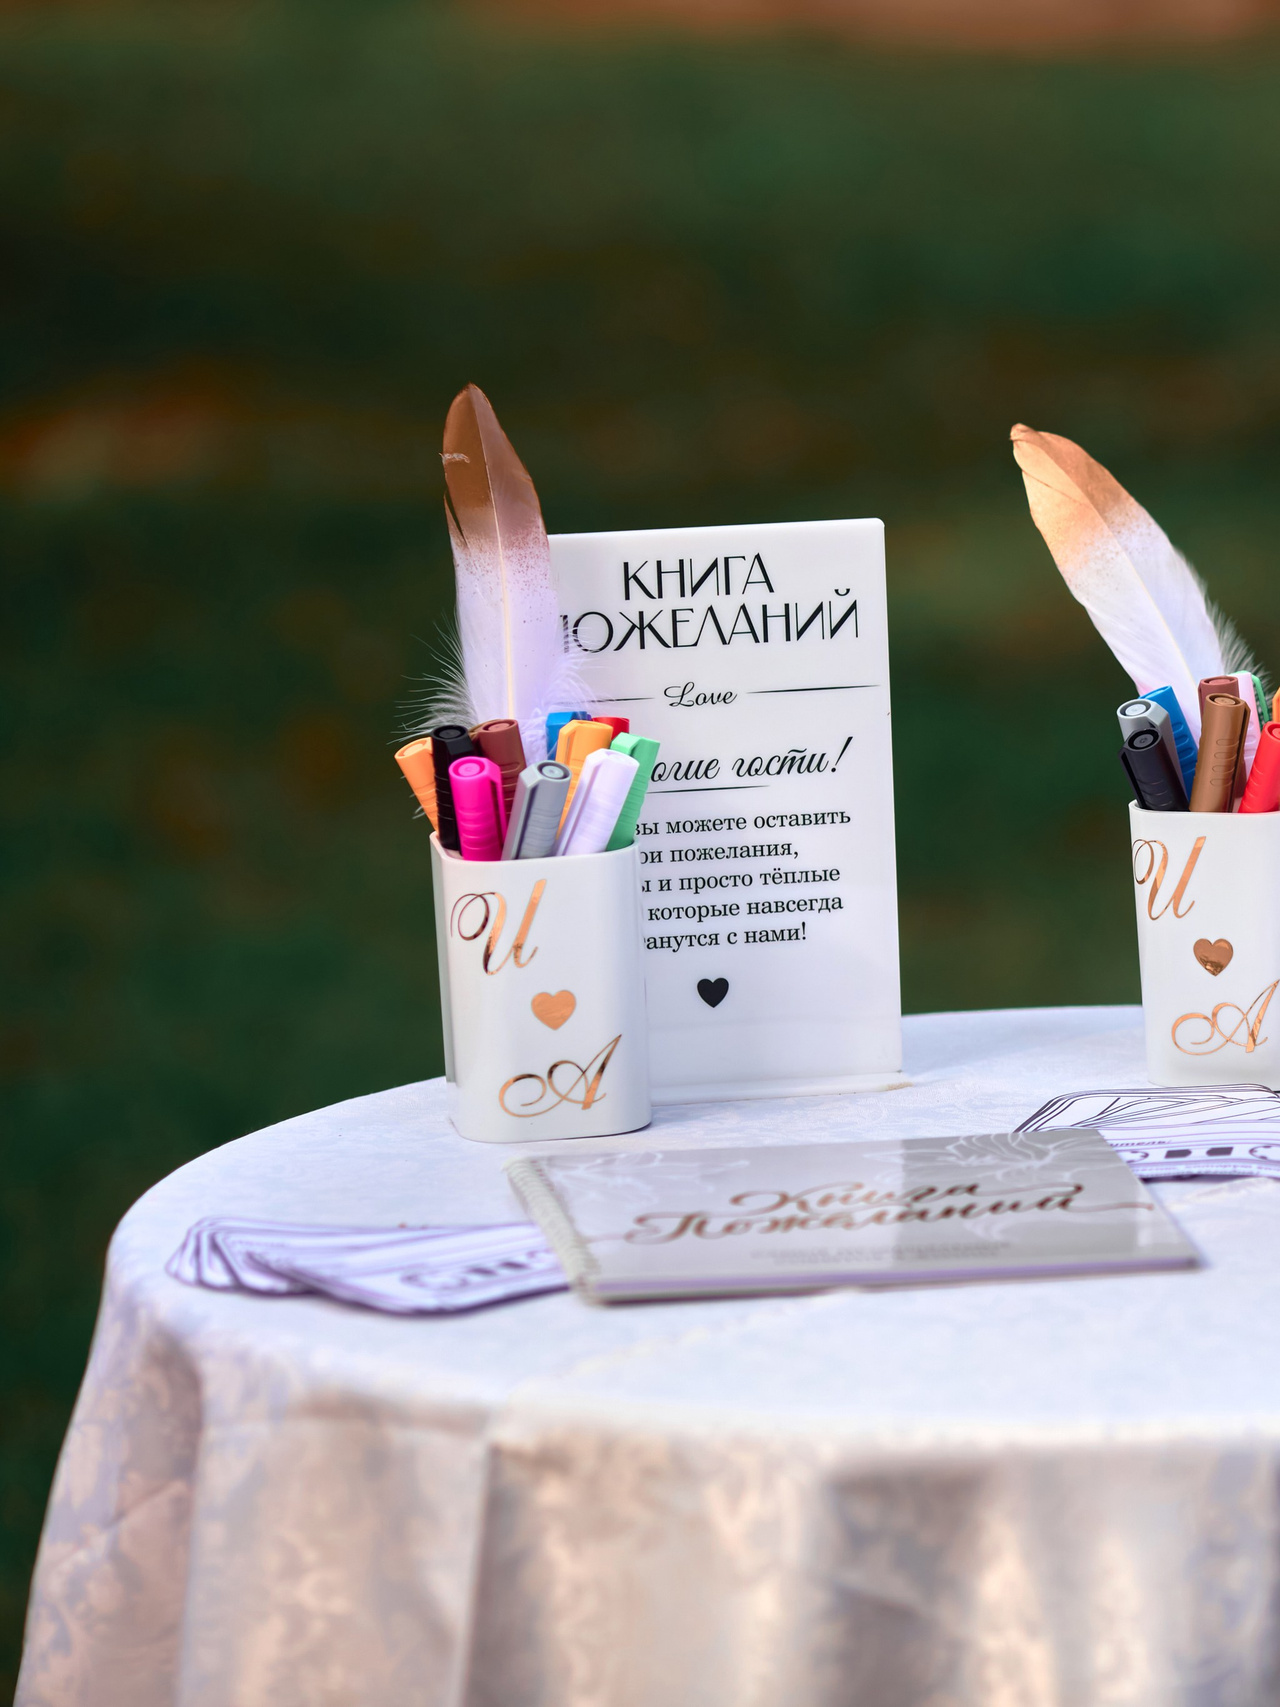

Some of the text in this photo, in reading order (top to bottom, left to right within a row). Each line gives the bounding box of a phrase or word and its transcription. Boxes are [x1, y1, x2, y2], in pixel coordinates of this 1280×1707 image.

[622, 553, 775, 601] КНИГА
[663, 681, 738, 708] Love
[650, 736, 853, 783] огие гости!
[666, 817, 747, 834] можете
[753, 811, 851, 829] оставить
[640, 842, 799, 865] ои пожелания,
[658, 878, 672, 892] и
[679, 873, 753, 895] просто
[760, 867, 841, 885] тёплые
[648, 896, 844, 923] которые навсегда
[644, 921, 807, 953] анутся с нами!
